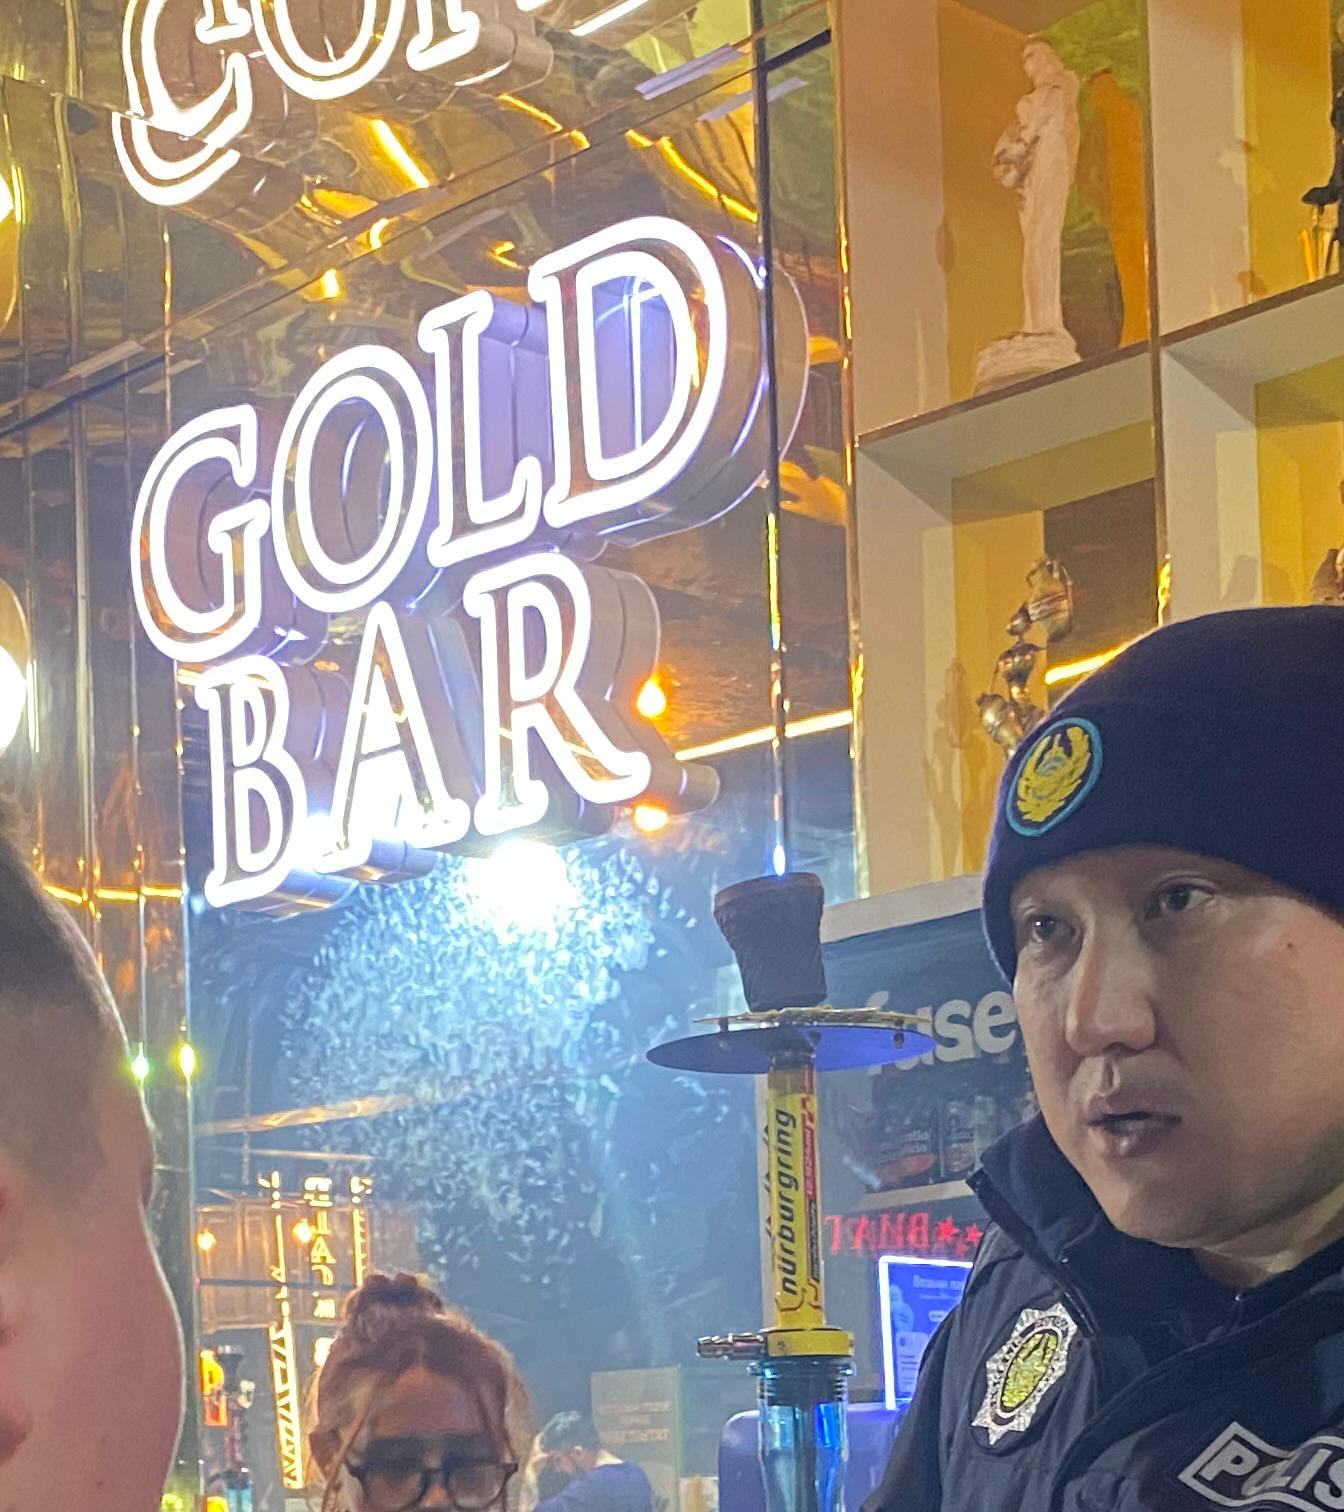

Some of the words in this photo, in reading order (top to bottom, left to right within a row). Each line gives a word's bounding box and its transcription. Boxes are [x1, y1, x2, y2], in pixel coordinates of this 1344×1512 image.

[130, 214, 728, 665] GOLD
[197, 550, 650, 908] BAR
[775, 1108, 799, 1296] nürburgring
